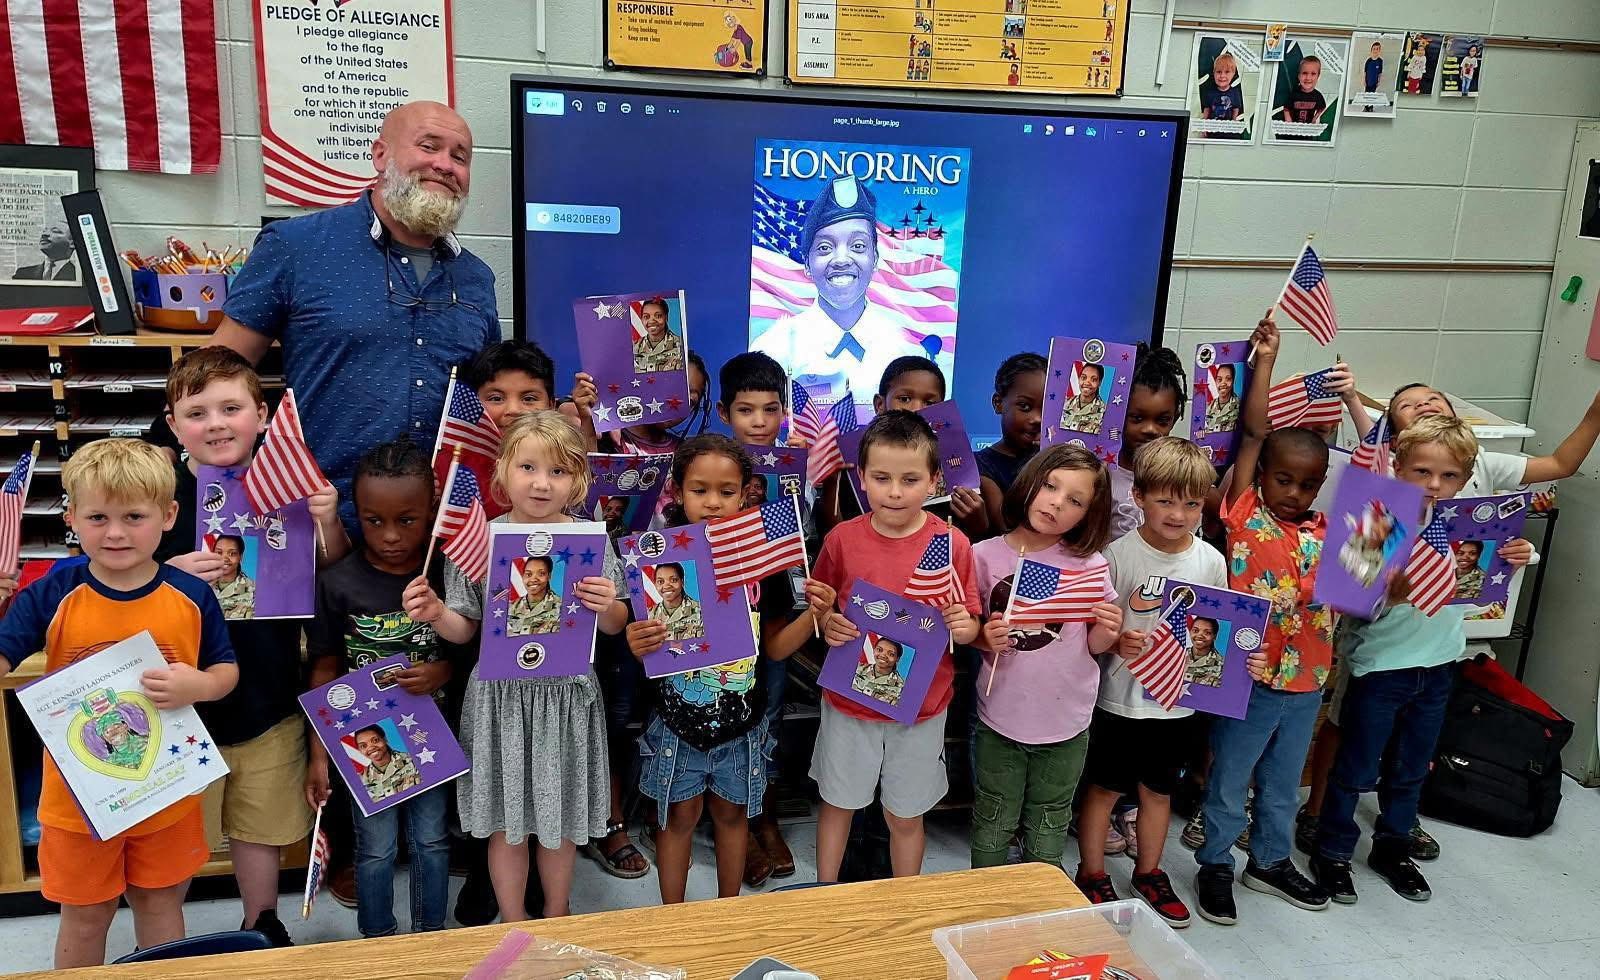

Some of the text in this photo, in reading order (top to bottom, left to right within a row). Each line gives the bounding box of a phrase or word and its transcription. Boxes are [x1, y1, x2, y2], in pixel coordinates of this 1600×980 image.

[617, 2, 675, 17] RESPONSIBLE
[267, 6, 440, 29] PLEDGE OF ALLEGIANCE
[815, 12, 830, 20] AREA
[296, 26, 409, 41] I pledge allegiance
[326, 42, 384, 55] to the flag
[300, 56, 408, 69] of the United States
[803, 61, 829, 69] ASSEMBLY
[324, 70, 387, 82] of America
[302, 84, 409, 99] and to the republic
[304, 97, 321, 108] for
[323, 98, 357, 109] which
[359, 99, 366, 109] it
[293, 108, 387, 120] one nation unde
[316, 136, 339, 146] with
[323, 151, 373, 162] justice fo
[762, 147, 962, 185] HONORING
[903, 186, 939, 196] A HERO
[54, 405, 66, 415] 20
[52, 685, 86, 706] KENNEDY
[86, 672, 112, 689] LADON
[111, 657, 143, 675] SANDERS
